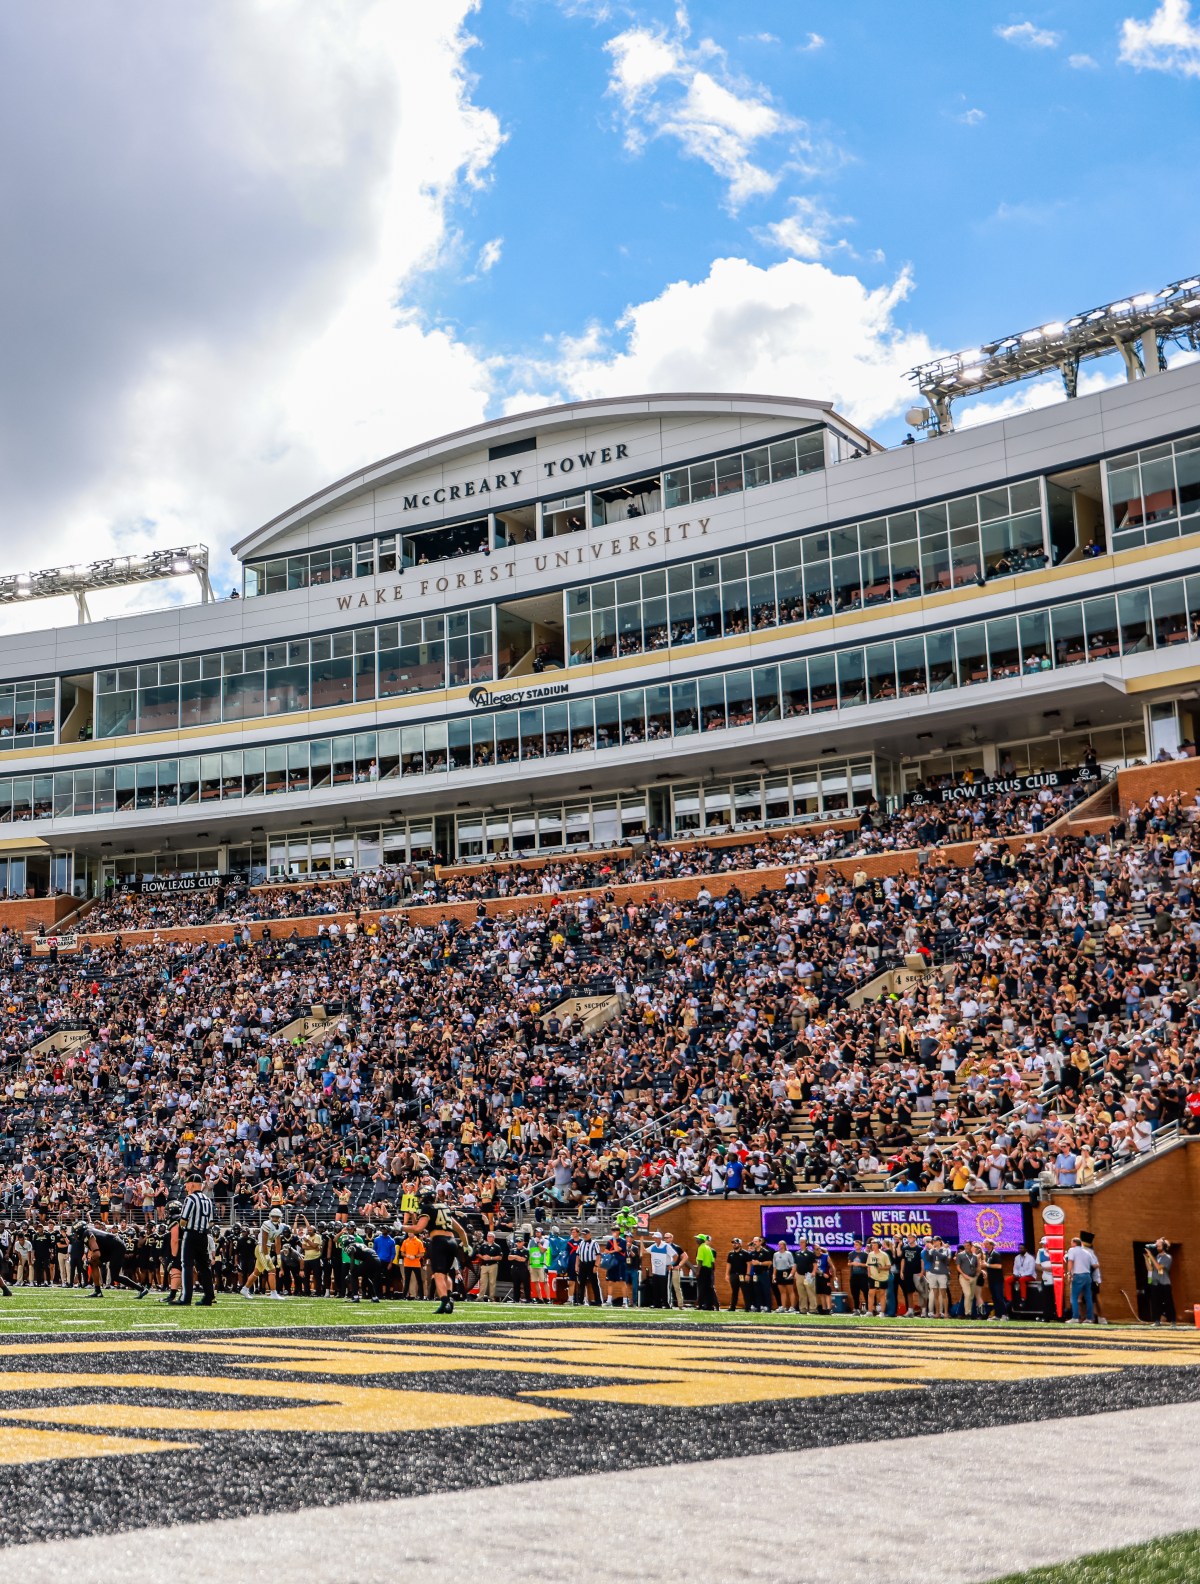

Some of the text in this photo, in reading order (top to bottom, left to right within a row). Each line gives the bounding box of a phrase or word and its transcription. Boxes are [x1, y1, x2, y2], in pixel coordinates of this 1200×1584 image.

[403, 443, 629, 511] McCREARY TOWER
[336, 517, 711, 611] WAKE FOREST UNIVERSITY
[475, 684, 569, 709] Allegacy STADIUM
[941, 773, 1058, 802] FLOW LEXUS CLUB
[141, 882, 166, 893] FLOW
[168, 879, 195, 890] LEXUS
[198, 877, 220, 888] CLUB
[895, 975, 902, 985] 4
[575, 1001, 610, 1012] 5 SECTION
[303, 1021, 309, 1030] 6
[63, 1035, 68, 1043] 7
[201, 1199, 210, 1215] U
[435, 1209, 453, 1230] 45
[637, 1214, 649, 1228] 3
[785, 1211, 842, 1233] planet
[871, 1210, 931, 1222] WE'RE ALL
[793, 1227, 855, 1246] fitness
[872, 1222, 933, 1236] STRONG
